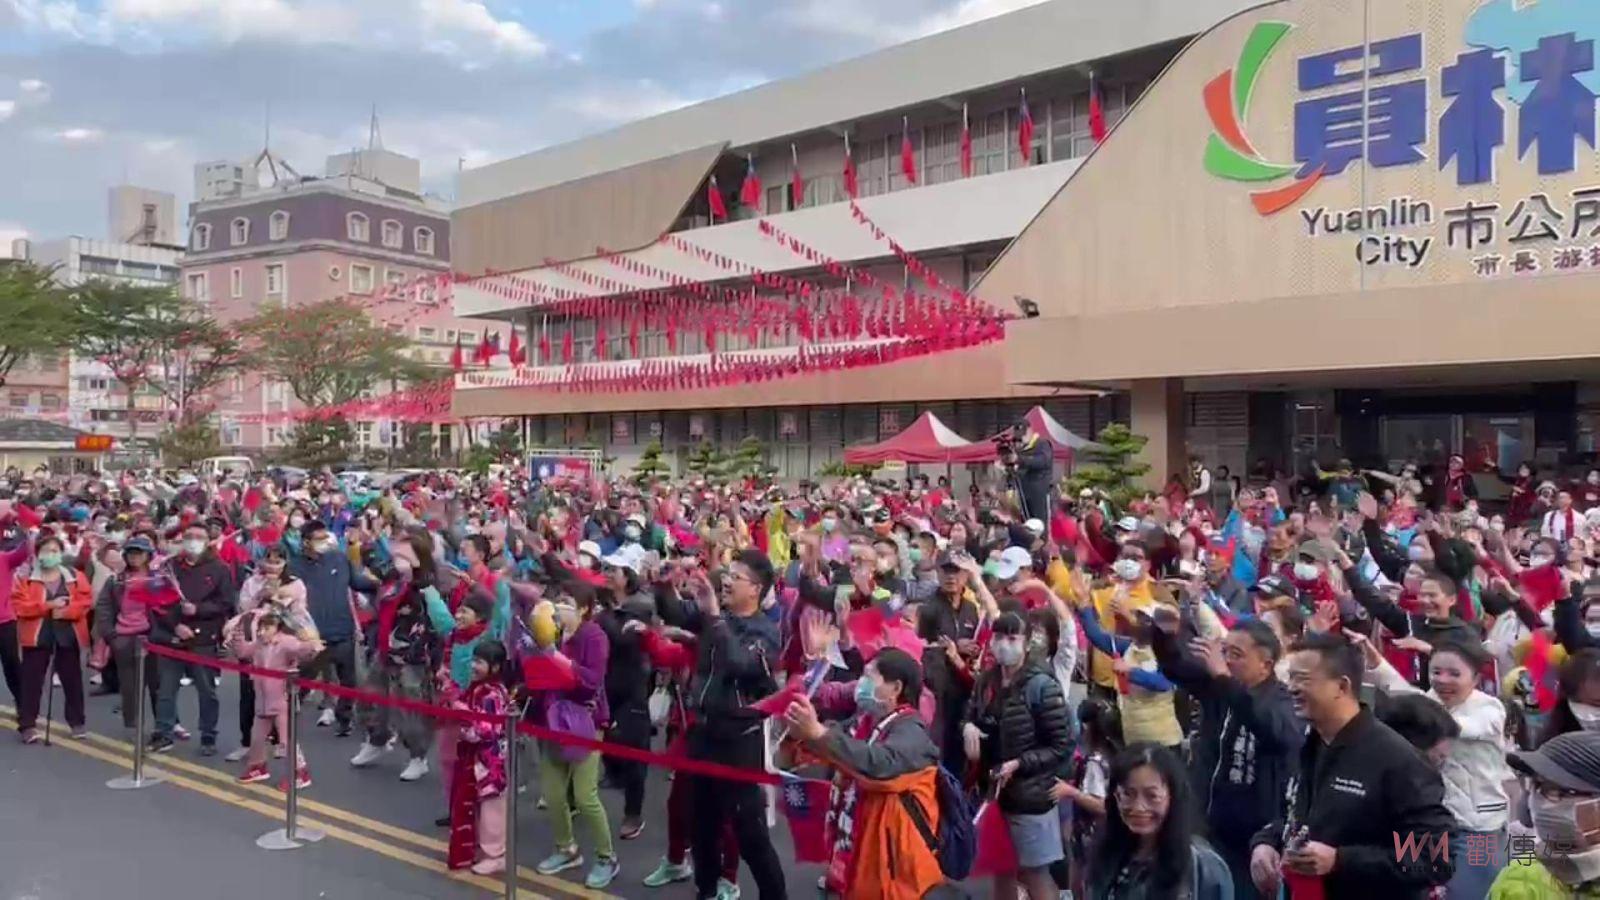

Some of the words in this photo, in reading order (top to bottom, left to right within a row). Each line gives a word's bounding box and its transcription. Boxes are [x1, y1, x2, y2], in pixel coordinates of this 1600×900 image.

[1294, 32, 1596, 185] 員林
[1301, 198, 1430, 235] Yuanlin
[1356, 236, 1430, 267] City
